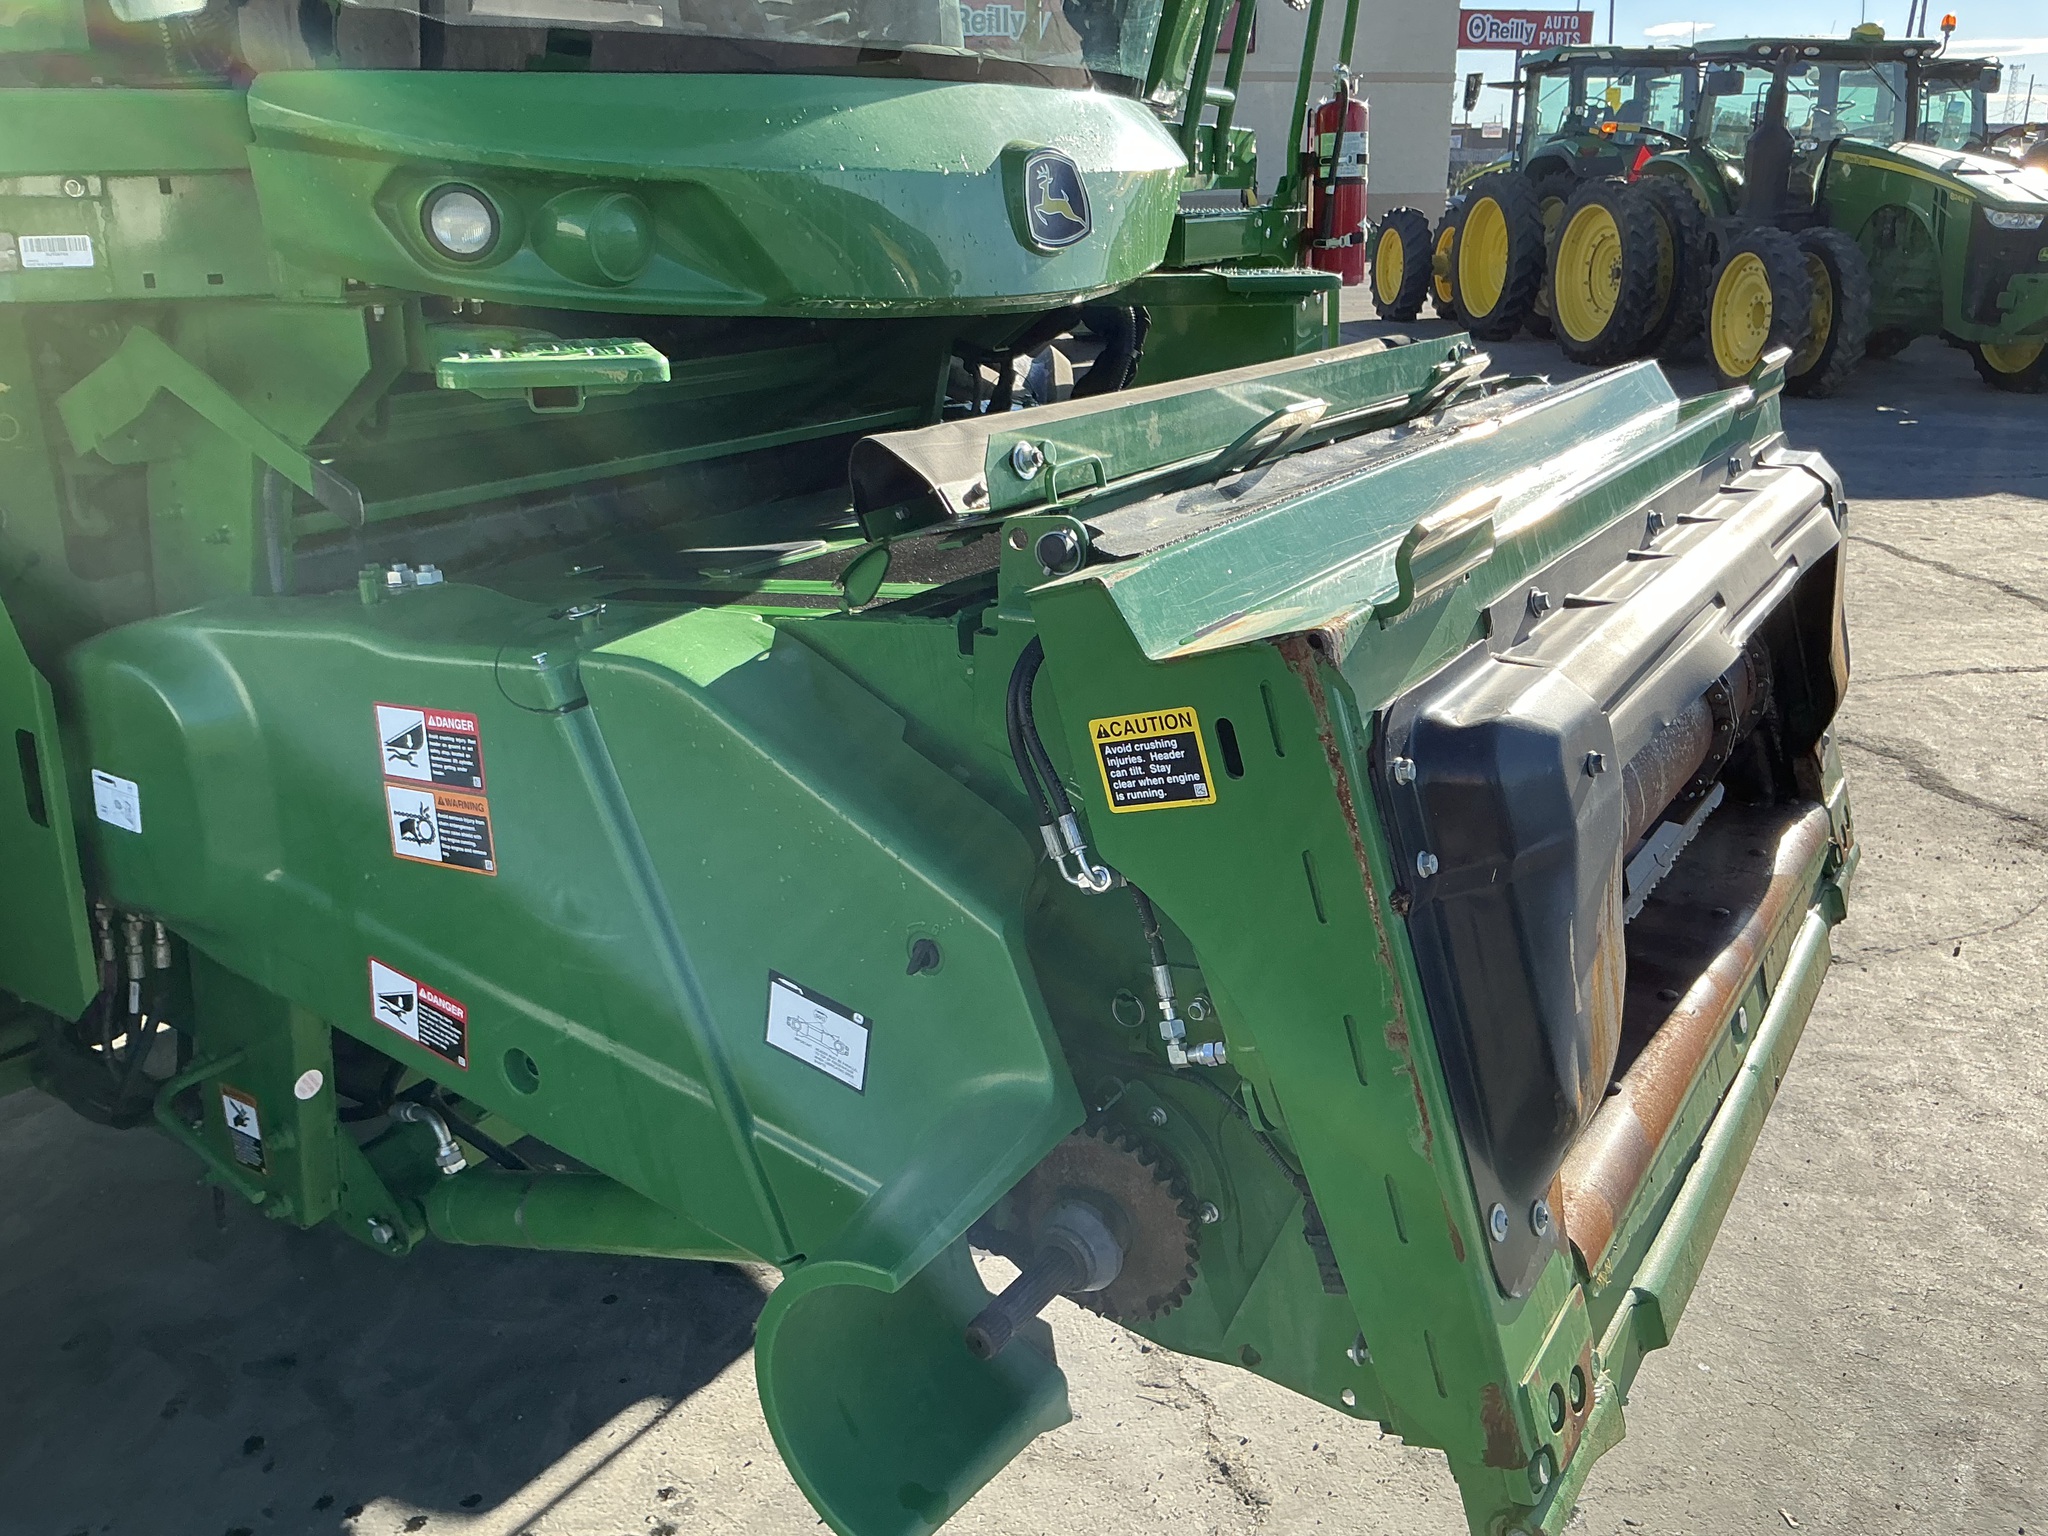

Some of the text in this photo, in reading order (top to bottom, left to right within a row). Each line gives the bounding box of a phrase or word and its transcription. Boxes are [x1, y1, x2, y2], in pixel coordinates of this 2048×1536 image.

[1467, 13, 1537, 45] O'Reilly
[1543, 15, 1579, 30] AUTO
[1539, 31, 1581, 46] PARTS
[435, 716, 475, 731] DANGER
[1110, 712, 1193, 737] CAUTION
[1104, 739, 1178, 756] Avoid crushing
[1106, 749, 1185, 768] injuries. Header
[1110, 763, 1172, 778] can tilt. Stay
[1113, 772, 1201, 789] clear when engine
[1115, 788, 1168, 801] is running.
[444, 798, 485, 813] WARNING
[426, 991, 464, 1019] DANGER
